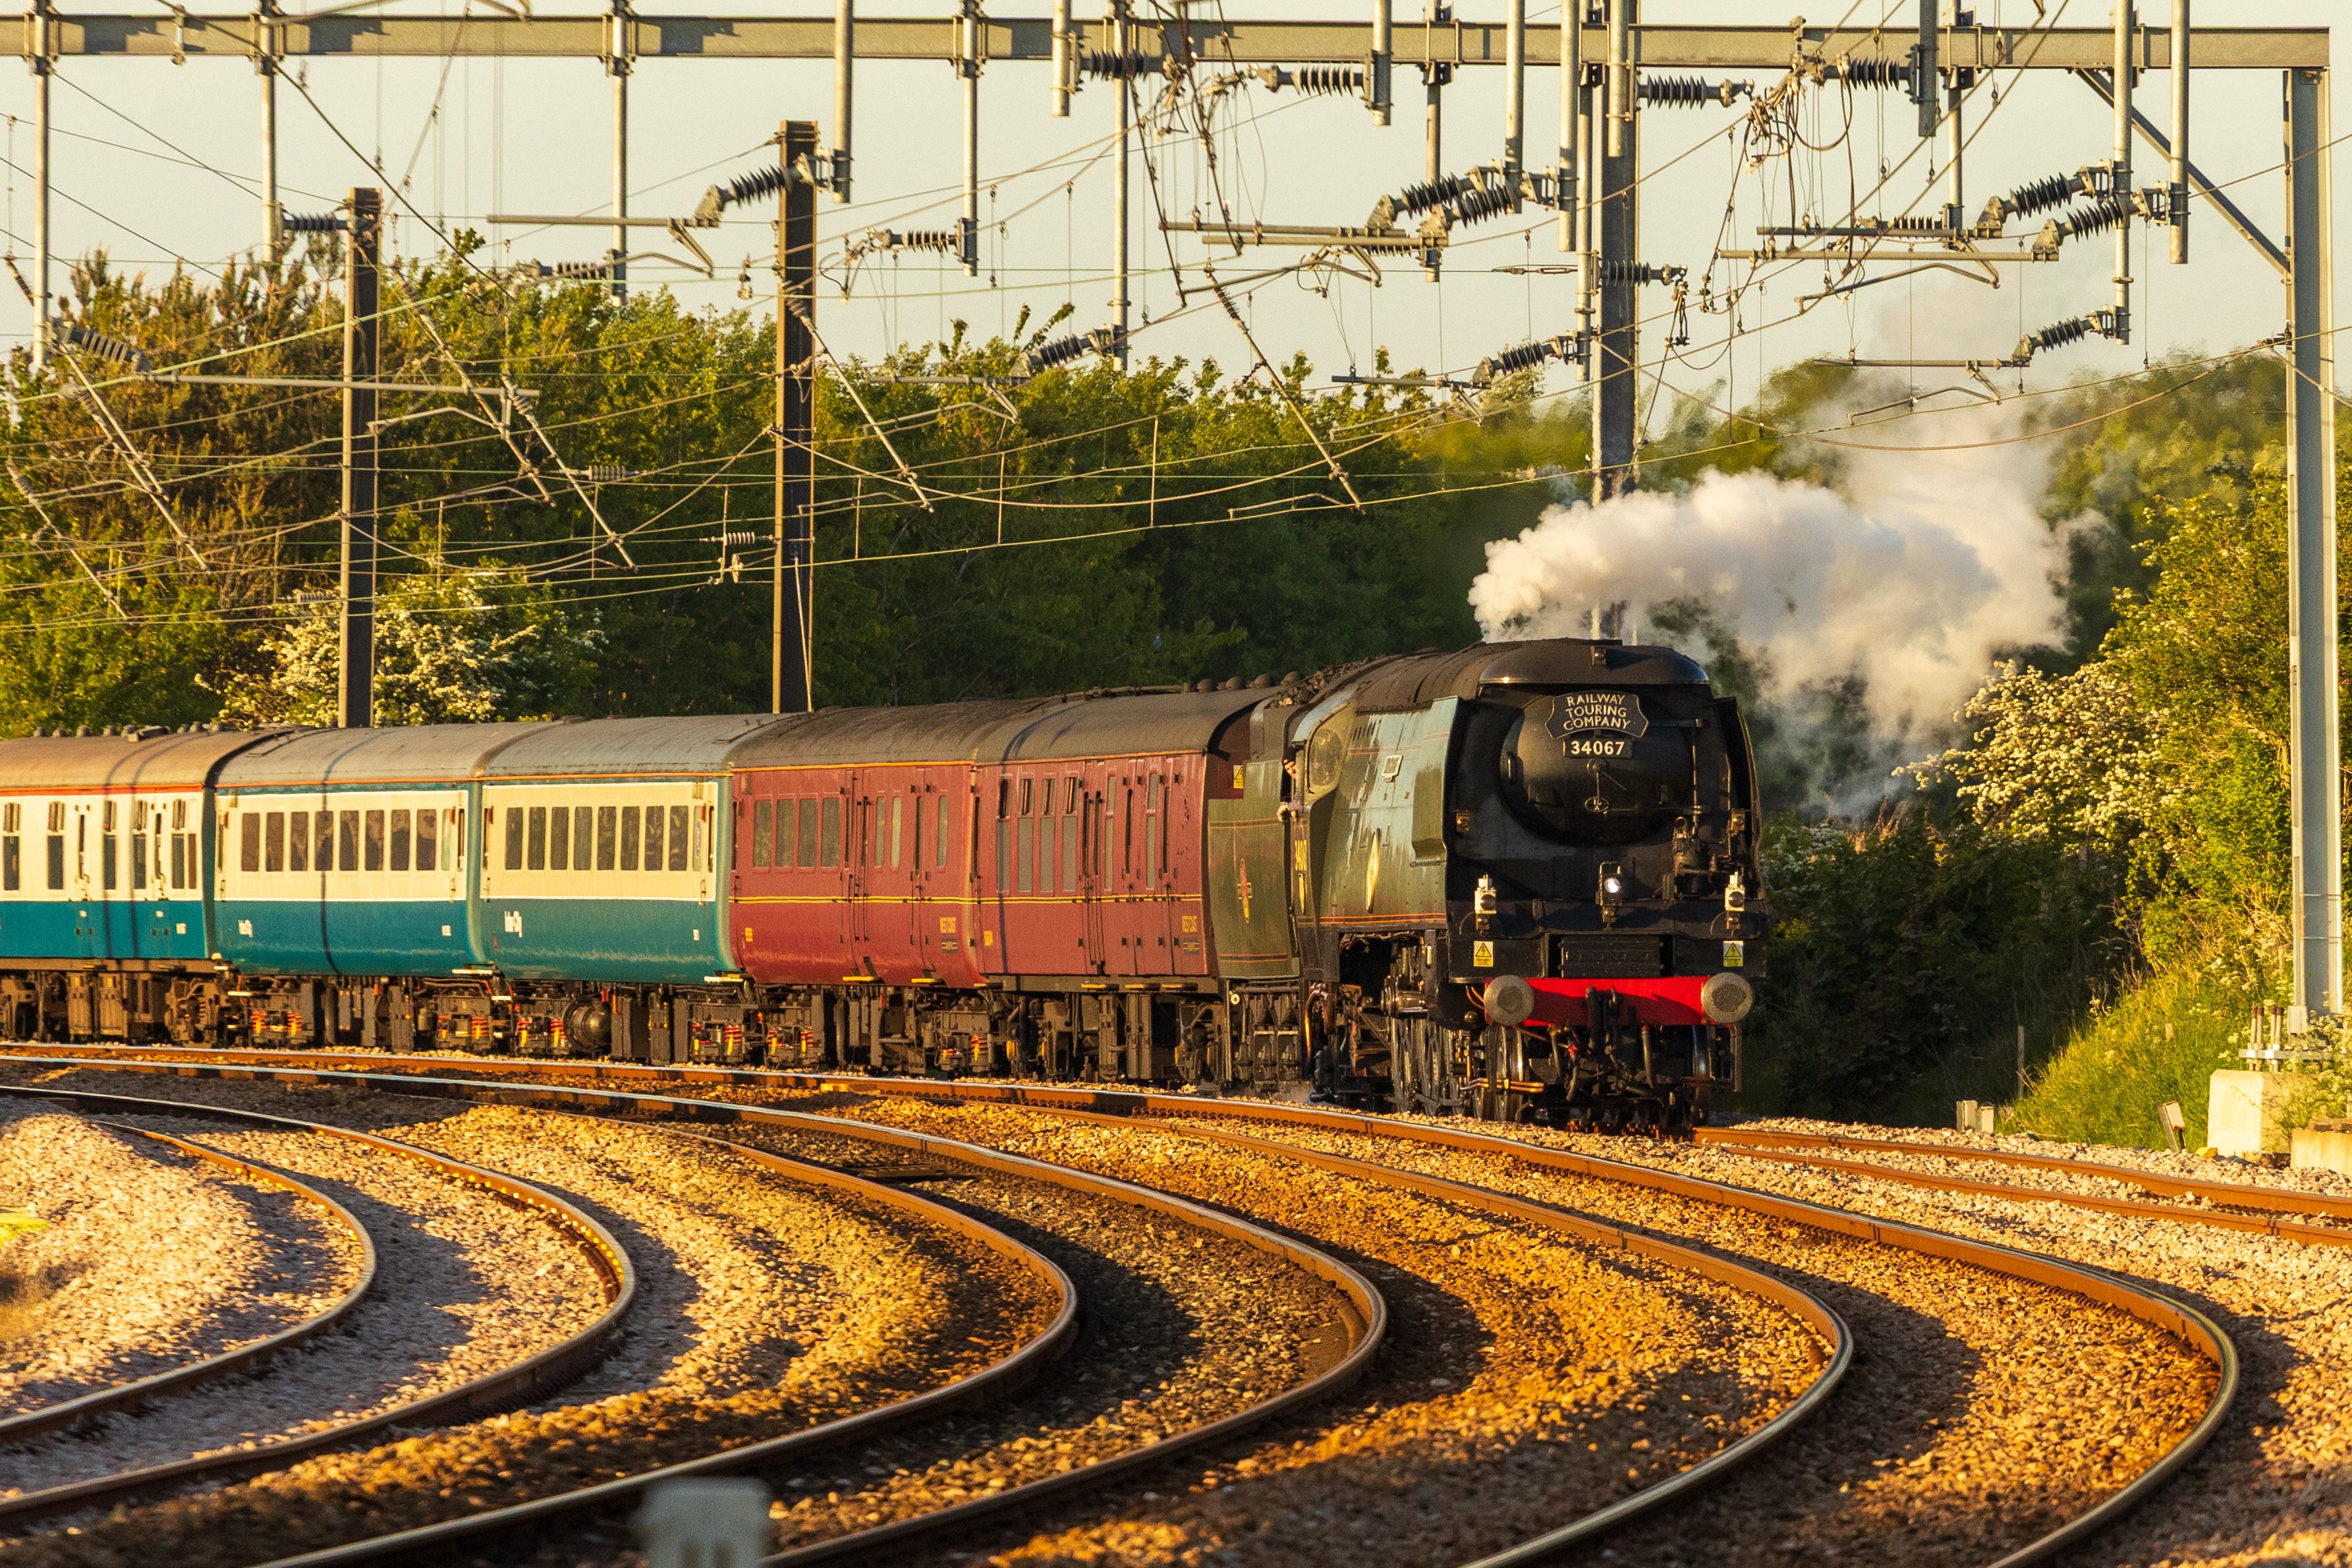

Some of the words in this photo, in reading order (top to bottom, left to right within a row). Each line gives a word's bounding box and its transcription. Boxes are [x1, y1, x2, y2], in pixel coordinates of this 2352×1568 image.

[1567, 694, 1625, 707] RAILWAY
[1565, 704, 1627, 718] TOURING
[1563, 715, 1631, 731] COMPANY
[1571, 741, 1625, 756] 34067
